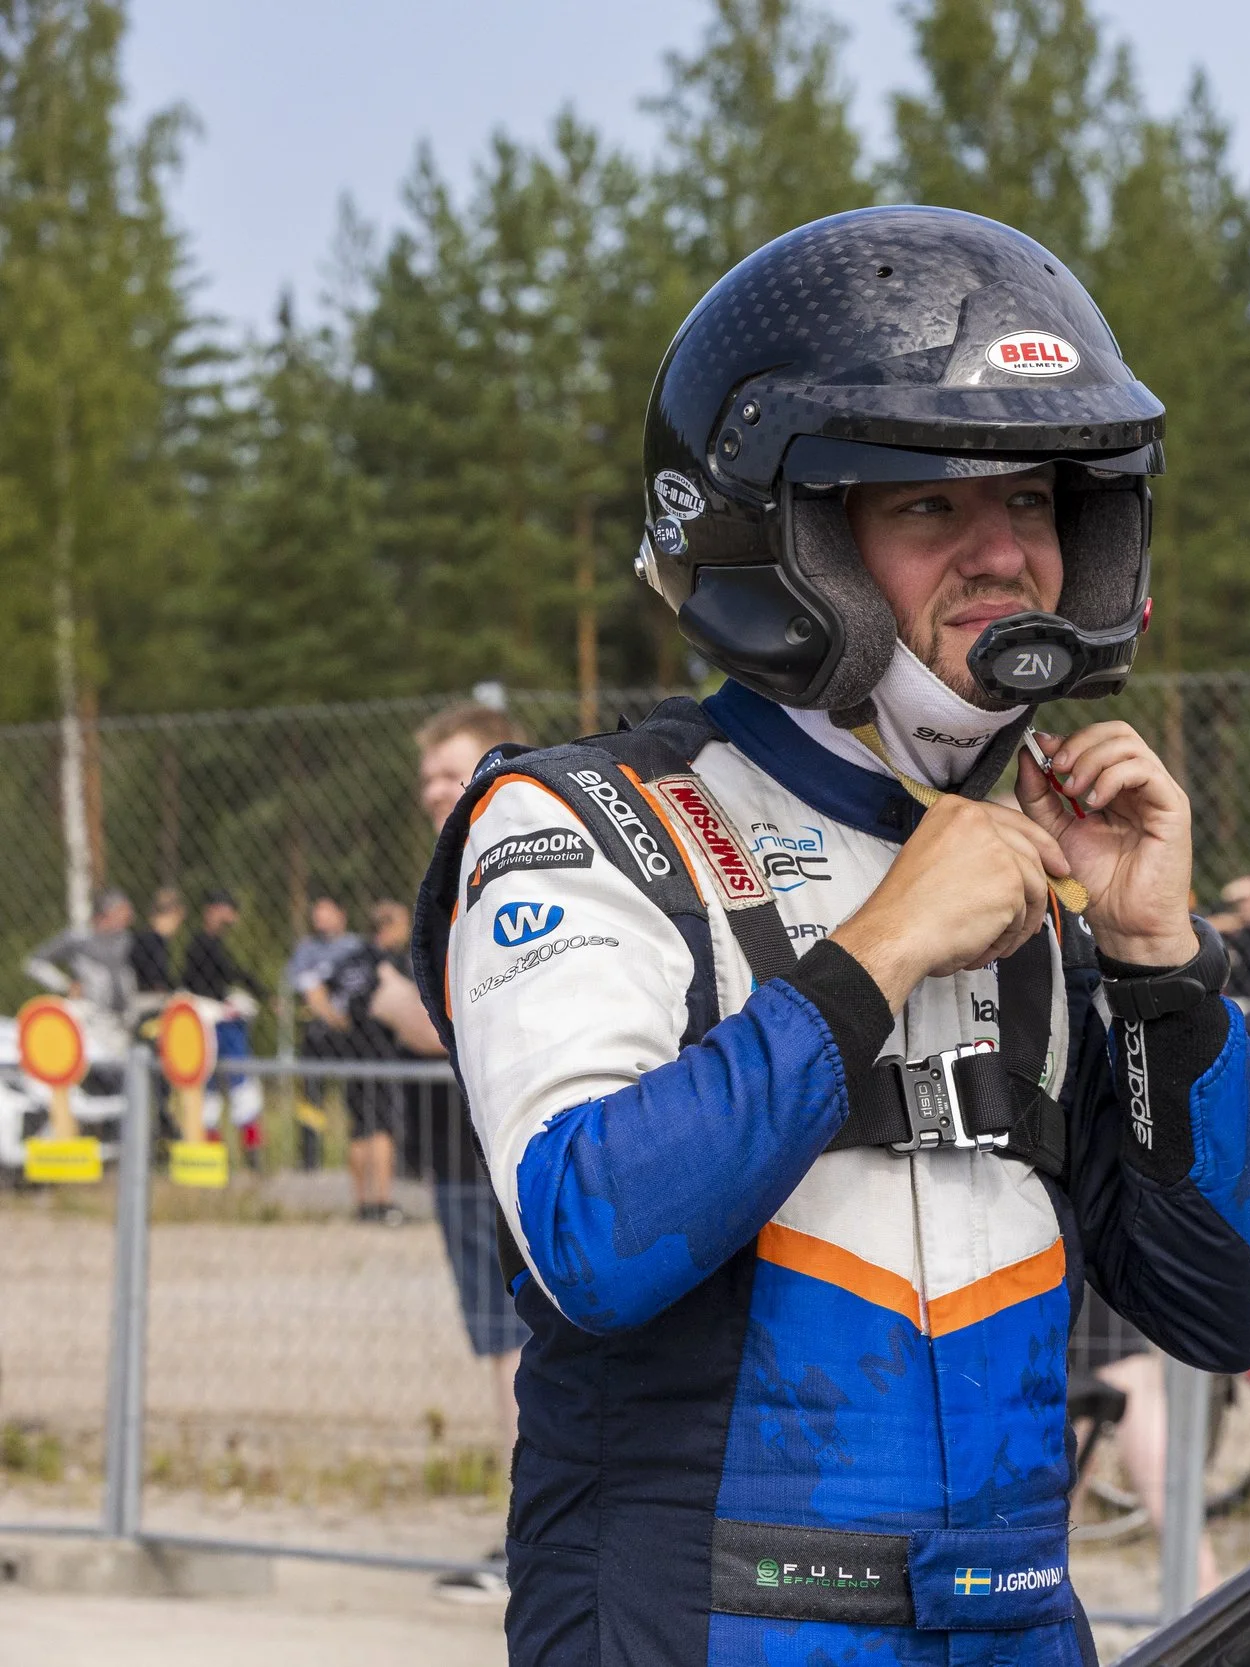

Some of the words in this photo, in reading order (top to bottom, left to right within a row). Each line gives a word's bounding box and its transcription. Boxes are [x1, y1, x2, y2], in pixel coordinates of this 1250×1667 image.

[1000, 342, 1069, 363] BELL
[663, 472, 691, 489] CARBON
[677, 491, 706, 513] RALLY
[665, 504, 687, 519] SERIES
[567, 770, 671, 882] sparco
[750, 822, 780, 833] FIA
[669, 787, 756, 892] SIMPSON
[497, 854, 533, 870] driving
[535, 851, 584, 862] emotion
[783, 1563, 881, 1580] FULL
[783, 1575, 881, 1589] EFFICIENCY
